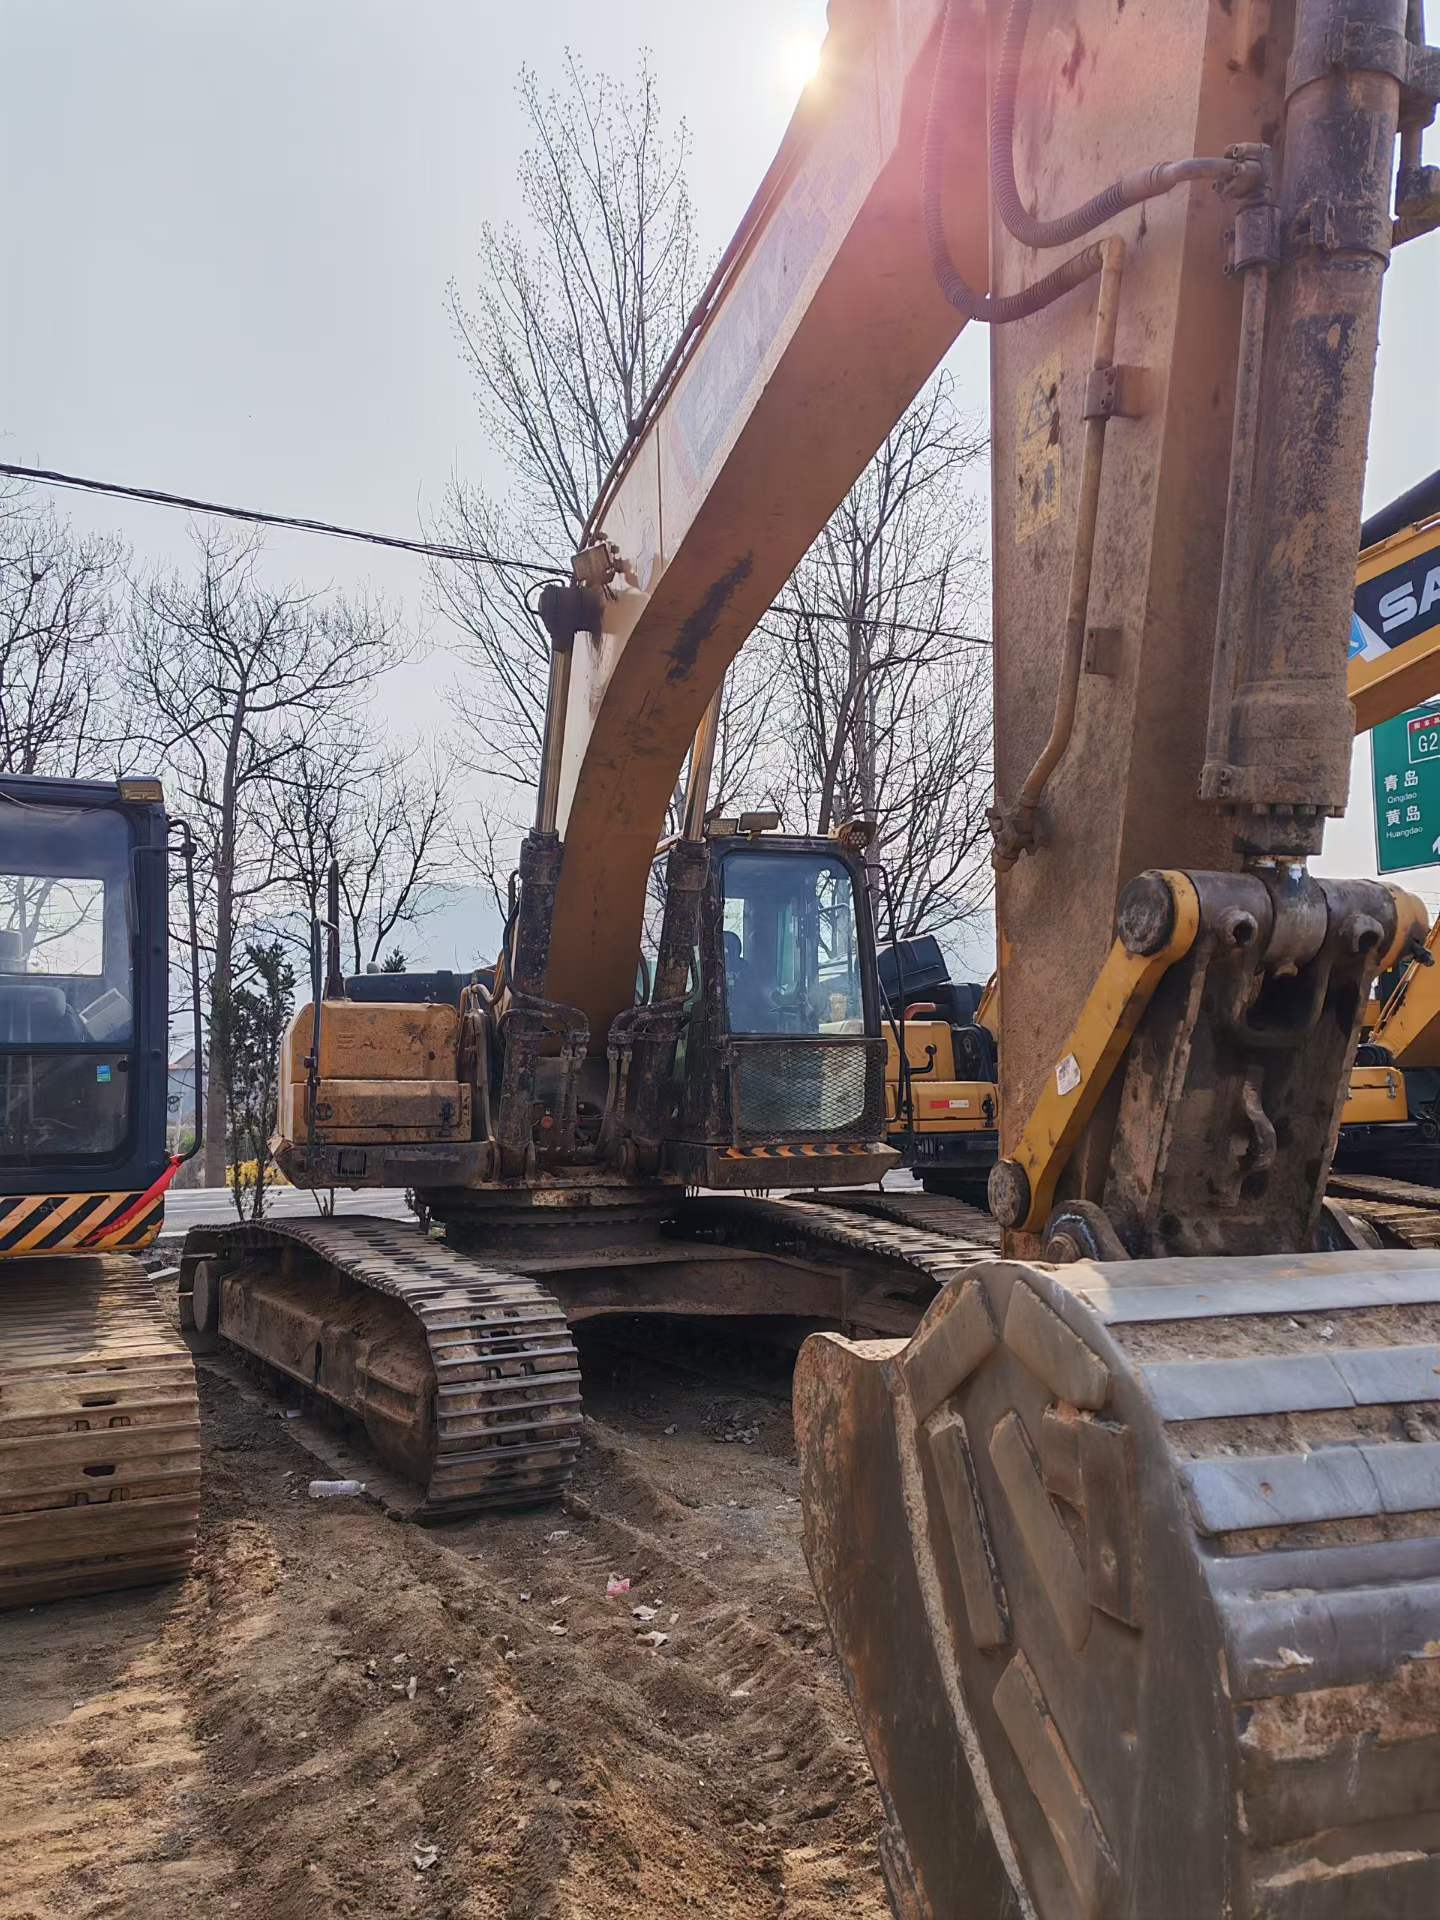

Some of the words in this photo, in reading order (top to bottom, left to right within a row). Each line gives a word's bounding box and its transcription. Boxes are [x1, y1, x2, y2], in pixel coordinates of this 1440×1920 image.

[1418, 732, 1438, 752] G2
[1384, 769, 1418, 792] 青岛
[1387, 792, 1418, 804] Qingdao
[1386, 805, 1420, 826] 黄岛
[1386, 827, 1423, 839] Huangdao
